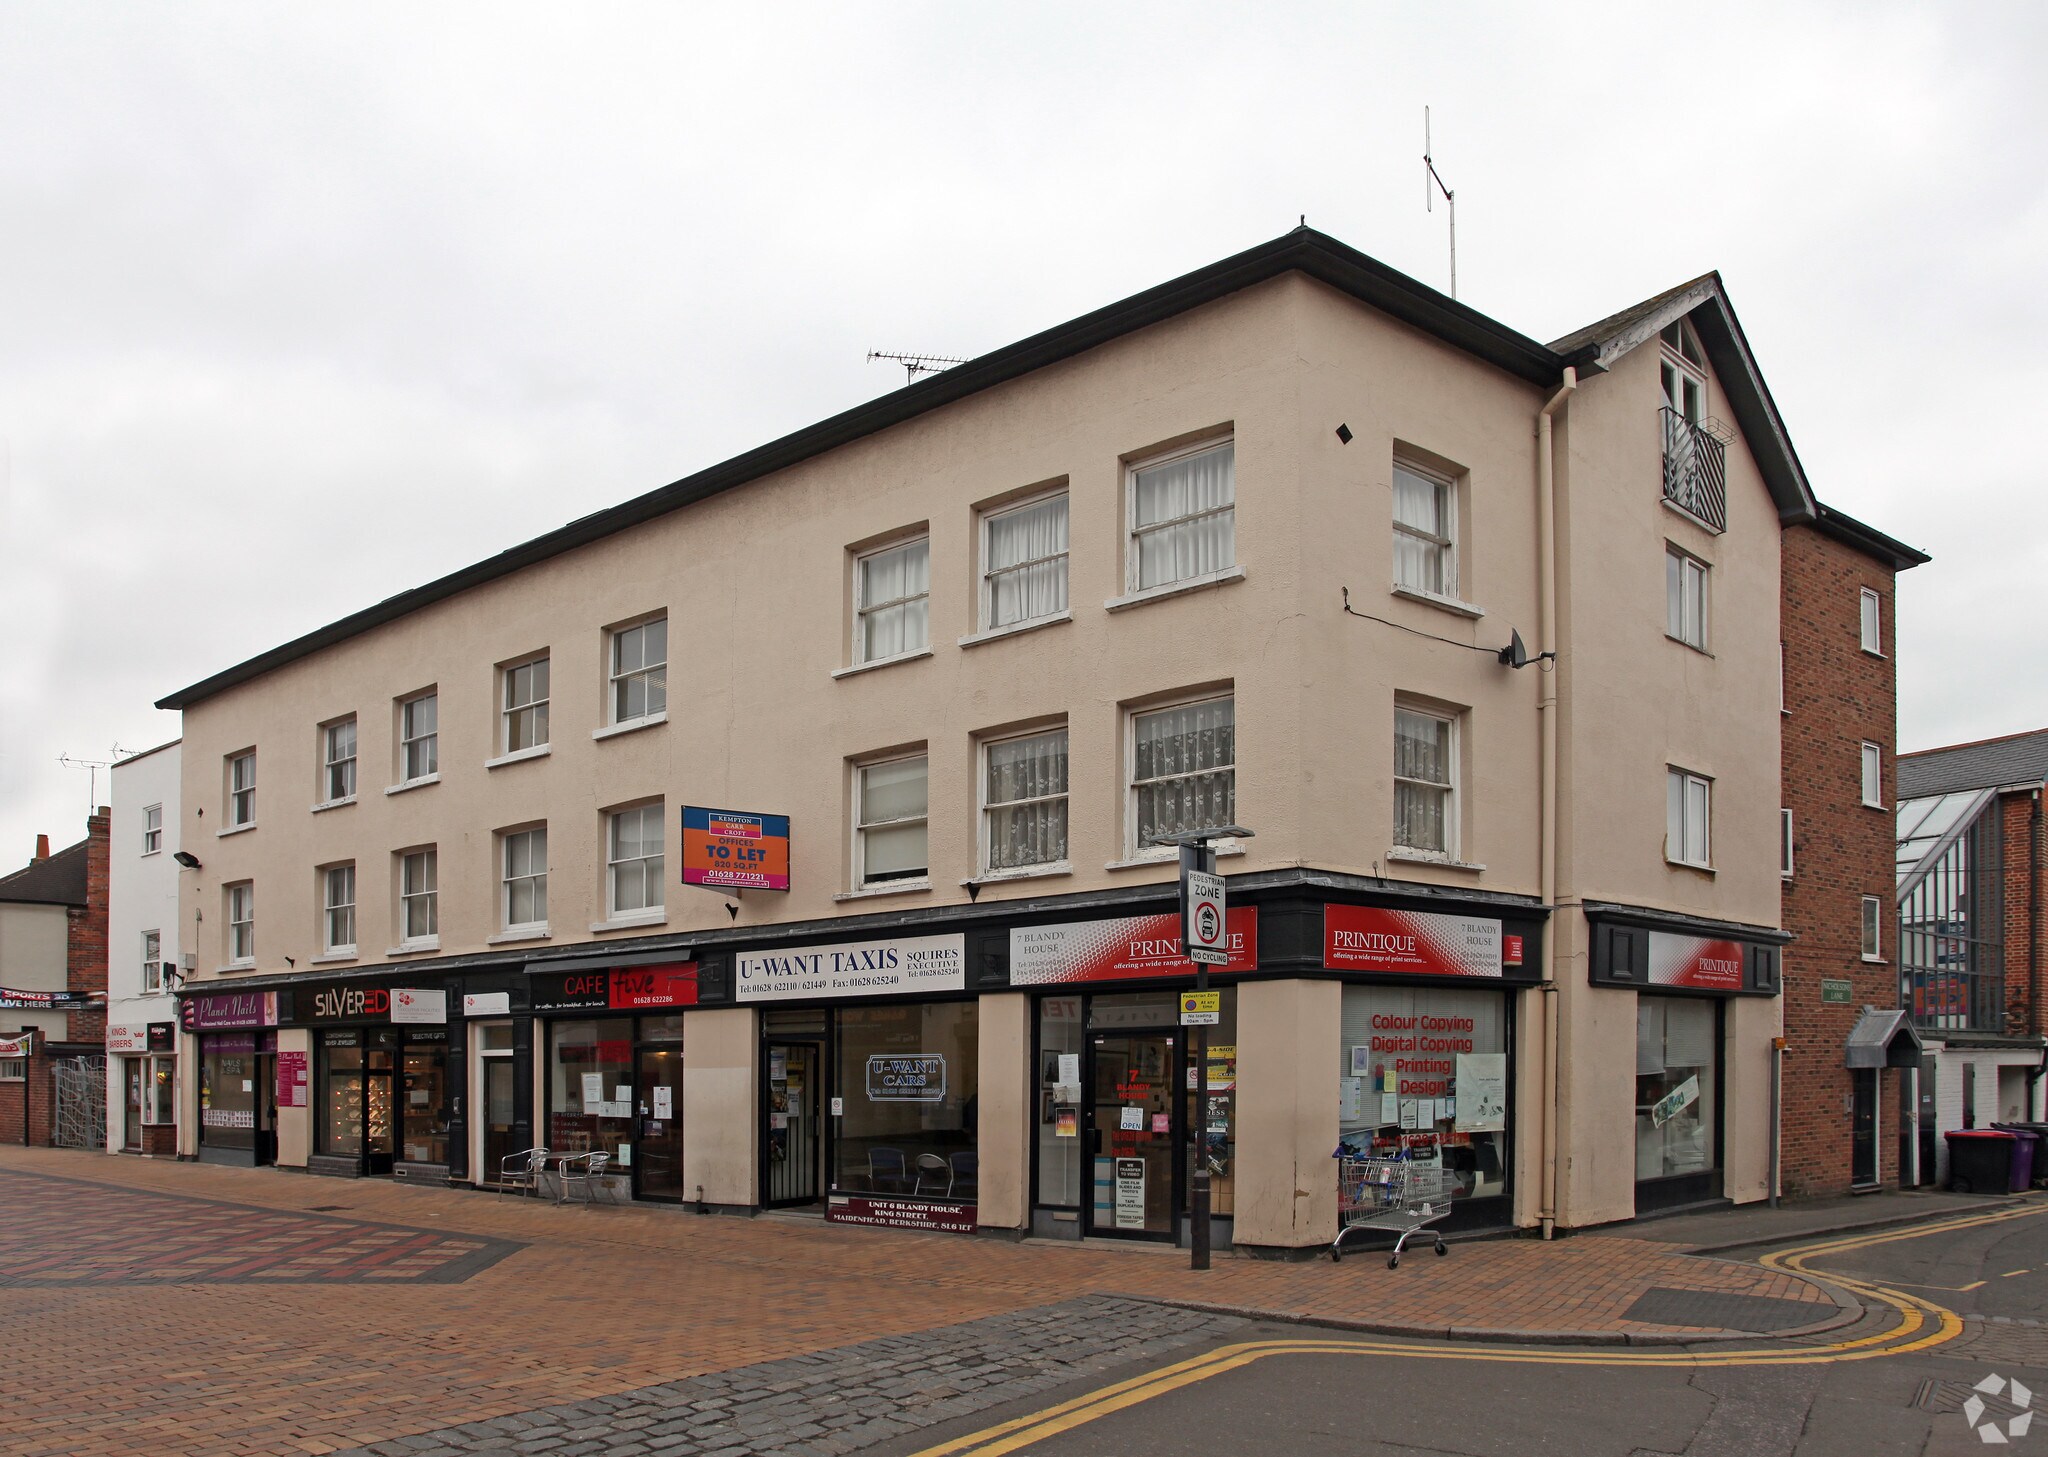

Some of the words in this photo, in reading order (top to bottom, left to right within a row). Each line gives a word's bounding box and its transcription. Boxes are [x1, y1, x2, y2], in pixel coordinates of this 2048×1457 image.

[719, 816, 752, 824] KEMPTON
[719, 838, 754, 846] OFFICES
[706, 846, 730, 858] TO
[738, 848, 766, 862] LET
[734, 862, 758, 870] SQ.FT
[708, 870, 734, 878] 01628
[736, 872, 764, 880] 771221
[1190, 874, 1225, 886] PEDESTRIAN
[1195, 885, 1220, 899] ZONE
[1461, 924, 1465, 932] 7
[1467, 924, 1497, 934] BLANDY
[1017, 935, 1022, 943] 7
[1024, 932, 1066, 942] BLANDY
[1334, 930, 1416, 953] PRINTIQUE
[1466, 937, 1492, 945] HOUSE
[1024, 944, 1058, 954] HOUSE
[906, 949, 958, 962] SQUIRES
[1192, 951, 1201, 960] NO
[1202, 952, 1227, 963] CYCLING
[1333, 952, 1353, 960] offering
[741, 954, 823, 978] U-WANT
[830, 948, 898, 972] TAXIS
[907, 960, 958, 970] EXECUTIVE
[1699, 958, 1738, 974] PRINTIQUE
[907, 970, 919, 978] Tel:
[564, 976, 604, 995] CAFE
[614, 968, 655, 1002] five
[740, 984, 752, 993] Tel:
[752, 983, 772, 992] 01628
[802, 980, 826, 989] 621449
[832, 979, 848, 988] Fax:
[850, 977, 871, 987] 01628
[872, 976, 899, 985] 625240
[1824, 982, 1850, 991] NICHOLSONS
[4, 990, 51, 1000] SPORTS
[1831, 992, 1843, 1000] LANE
[199, 998, 228, 1020] Planet
[232, 994, 257, 1017] Nails
[315, 988, 390, 1018] SILVERED
[1372, 1014, 1418, 1029] Colour
[1421, 1016, 1474, 1032] Copying
[111, 1027, 127, 1036] KINGS
[109, 1039, 133, 1048] BARBERS
[380, 1034, 386, 1042] &
[1372, 1036, 1416, 1053] Digital
[1420, 1036, 1472, 1053] Copying
[222, 1059, 240, 1067] NAILS
[873, 1060, 938, 1074] U-WANT
[1396, 1058, 1450, 1074] Printing
[883, 1075, 926, 1086] CARS
[1129, 1070, 1138, 1082] 7
[1400, 1079, 1446, 1096] Design
[1396, 1134, 1429, 1147] 01628
[930, 1206, 963, 1214] HOUSE,
[834, 1214, 888, 1225] MAIDENHEAD,
[889, 1219, 939, 1229] BERKSHIRE,
